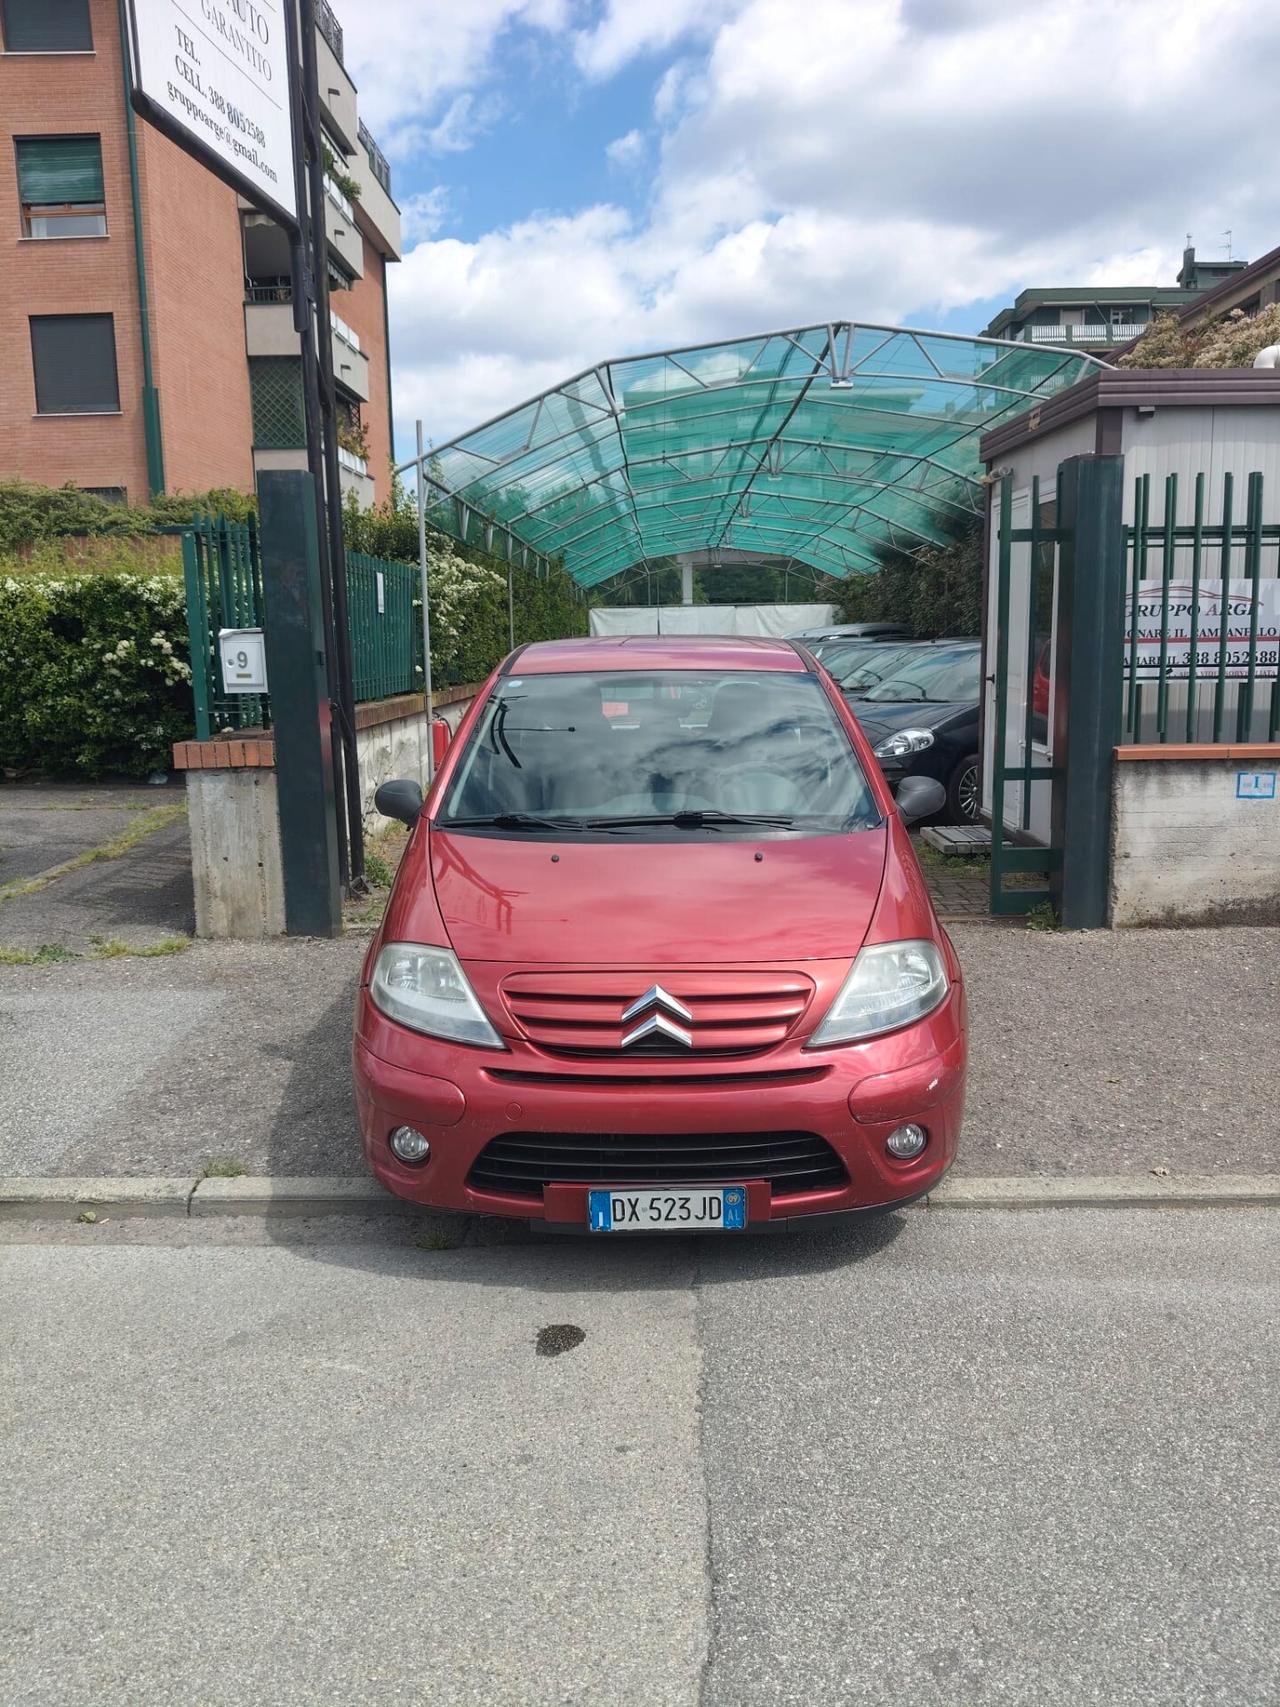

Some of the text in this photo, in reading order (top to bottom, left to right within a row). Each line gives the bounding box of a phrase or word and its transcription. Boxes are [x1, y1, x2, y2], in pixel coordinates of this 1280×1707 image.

[174, 25, 201, 66] TEL.
[174, 54, 266, 149] CELL. 388 8052588
[167, 81, 278, 184] gruppoarge@gmail.com
[237, 651, 248, 669] 9
[1214, 651, 1277, 664] 805288
[612, 1198, 640, 1222] DX
[728, 1209, 740, 1221] AL
